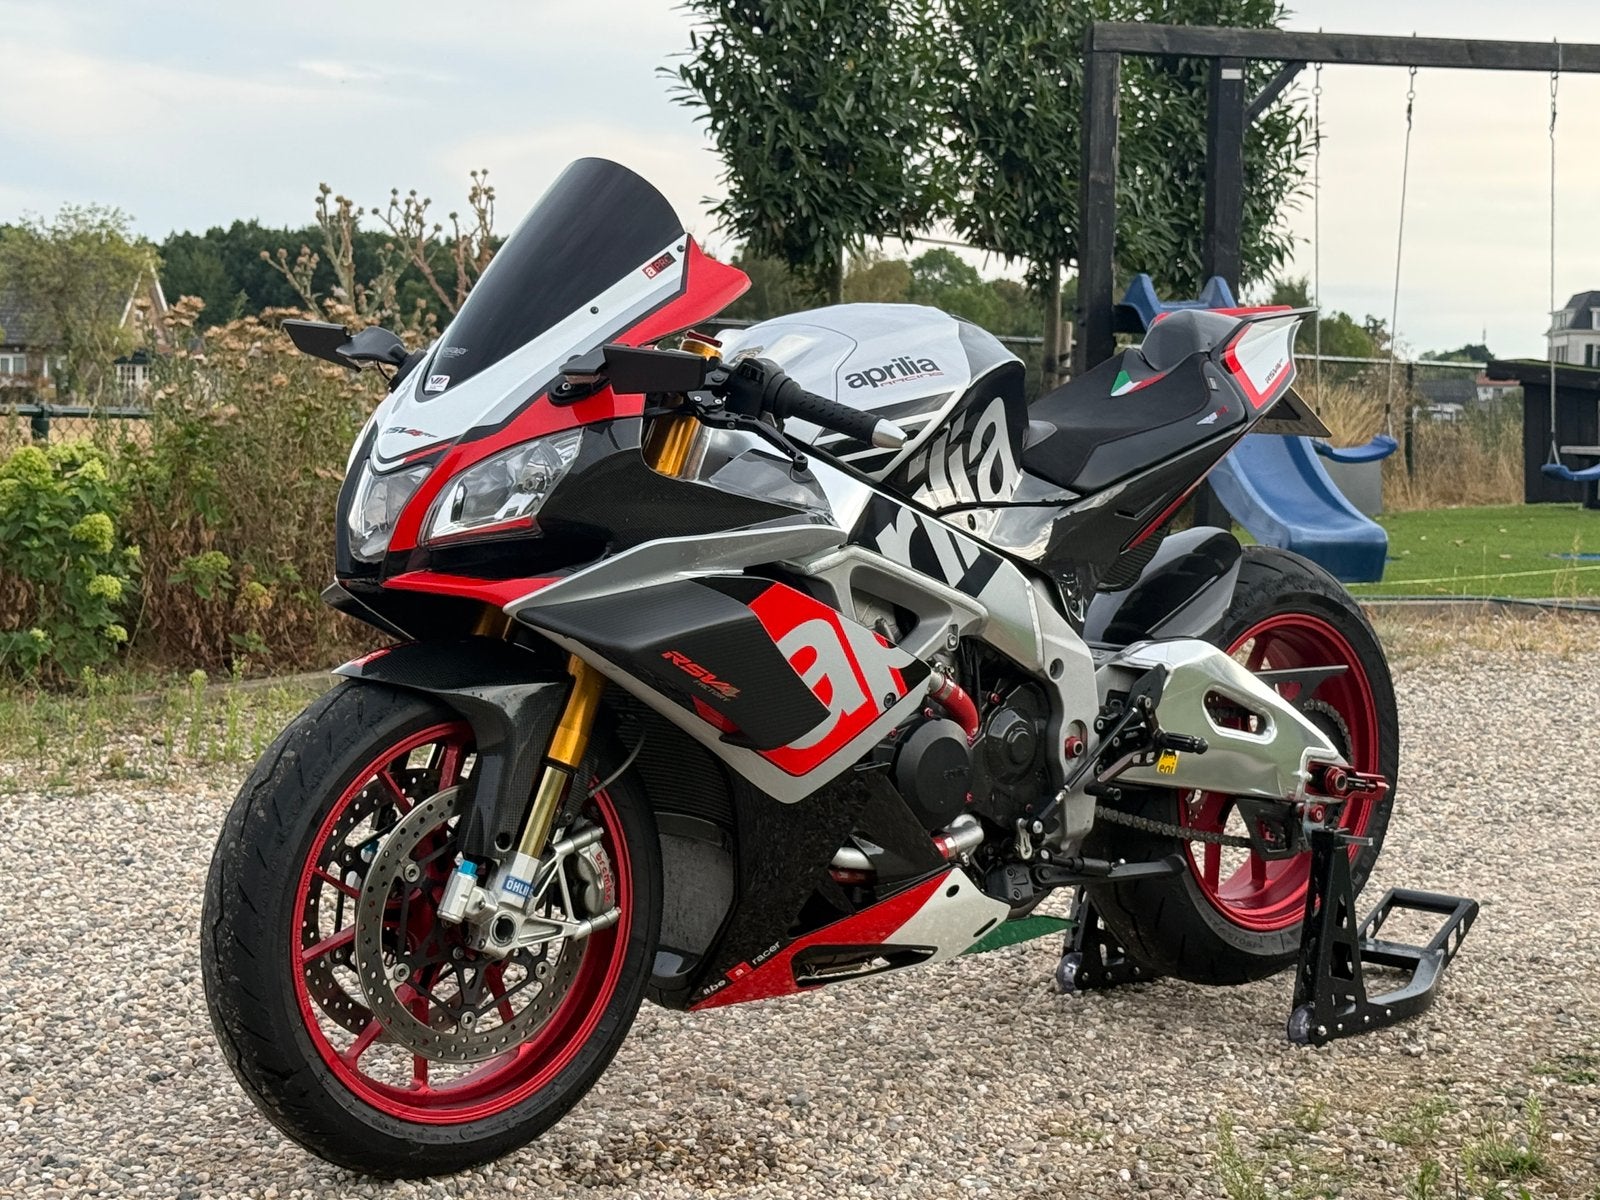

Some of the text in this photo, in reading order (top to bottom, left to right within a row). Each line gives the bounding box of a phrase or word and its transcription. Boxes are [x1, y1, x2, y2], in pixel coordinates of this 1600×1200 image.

[844, 356, 941, 389] aprilia
[661, 650, 741, 698] RSV4
[1159, 761, 1175, 774] eni
[752, 941, 780, 965] racer
